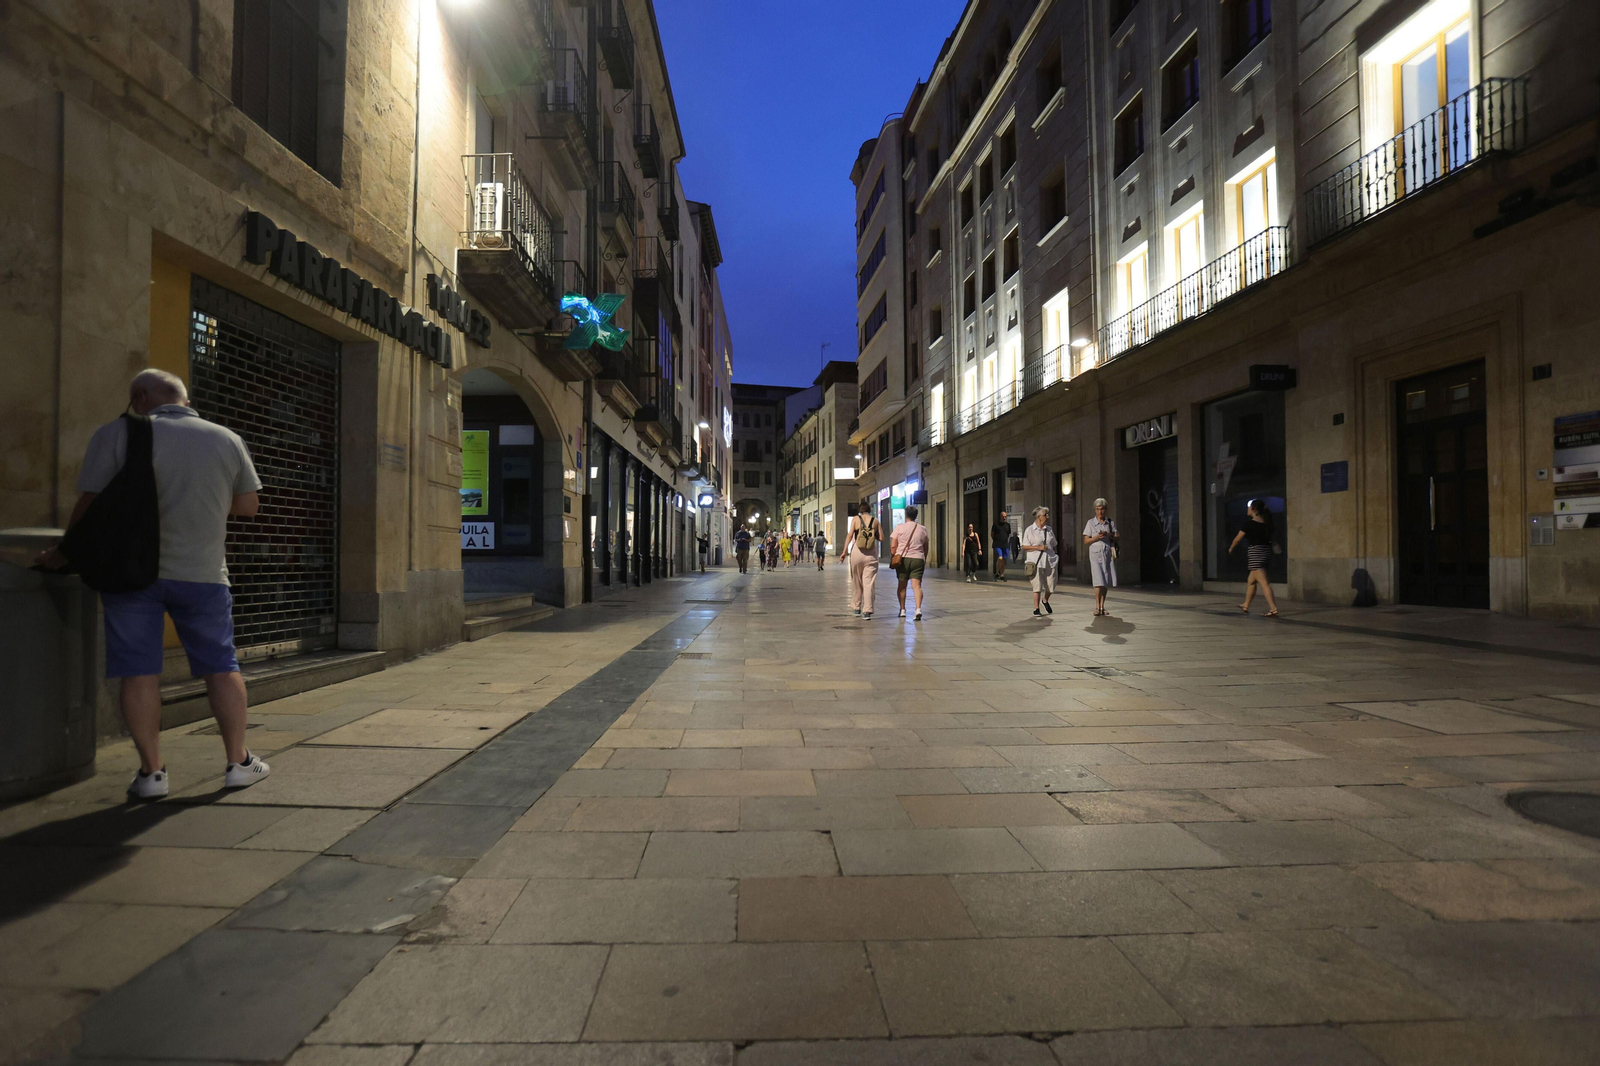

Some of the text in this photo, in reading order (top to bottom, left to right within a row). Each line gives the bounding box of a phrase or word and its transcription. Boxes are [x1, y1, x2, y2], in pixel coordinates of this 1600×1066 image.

[246, 210, 451, 369] PARAFARMACIA
[1260, 372, 1285, 381] DRUNI
[1130, 414, 1170, 444] DRUNI
[1558, 434, 1581, 443] RUBÉN
[966, 476, 987, 491] MANGO
